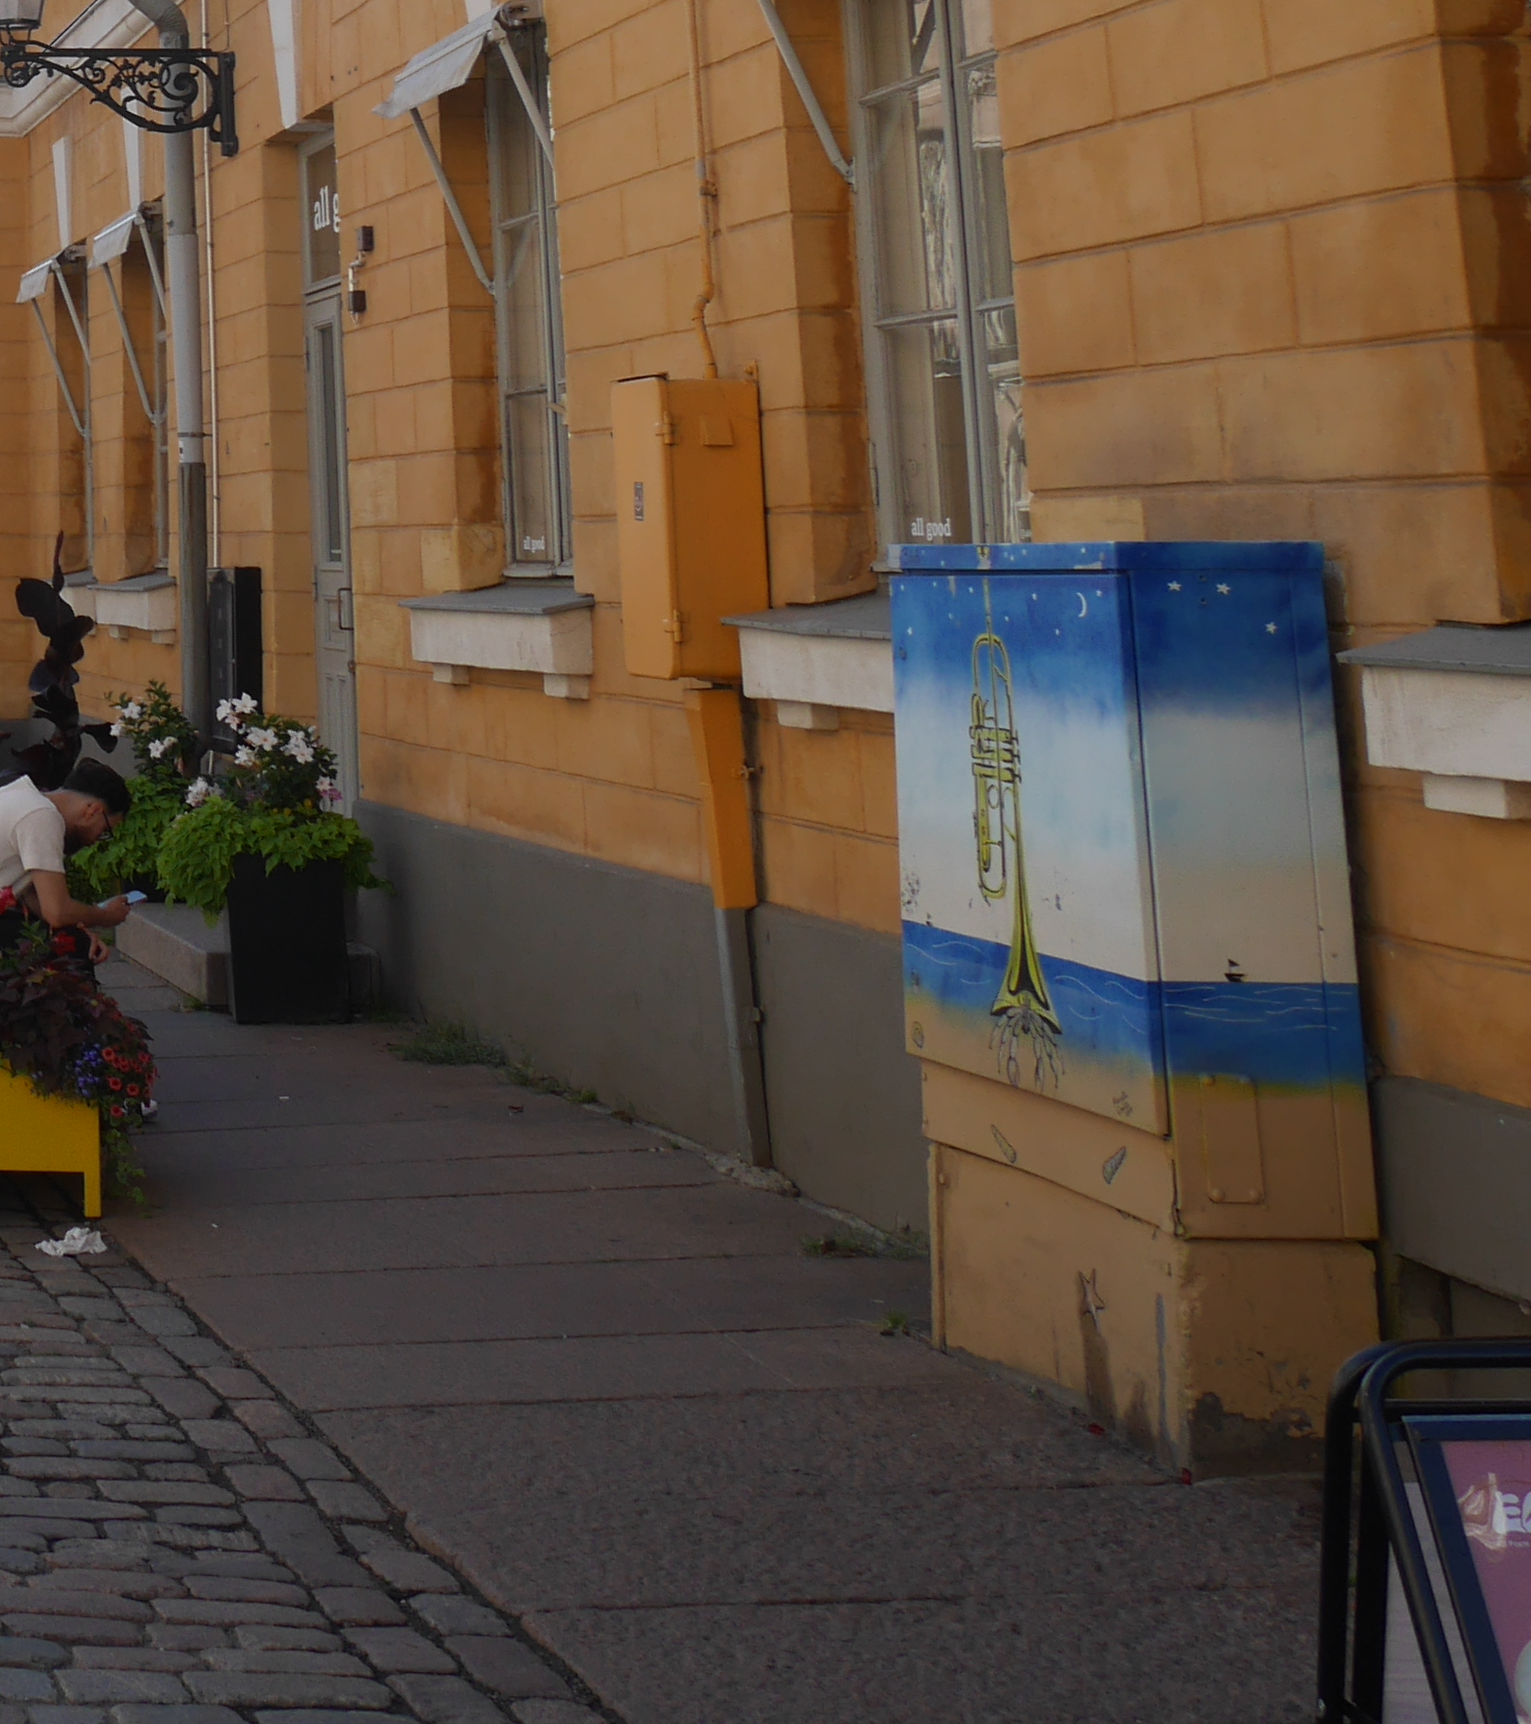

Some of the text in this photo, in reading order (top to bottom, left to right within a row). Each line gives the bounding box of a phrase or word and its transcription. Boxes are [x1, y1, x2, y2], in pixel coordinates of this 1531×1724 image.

[314, 185, 330, 231] all
[911, 517, 952, 542] all good
